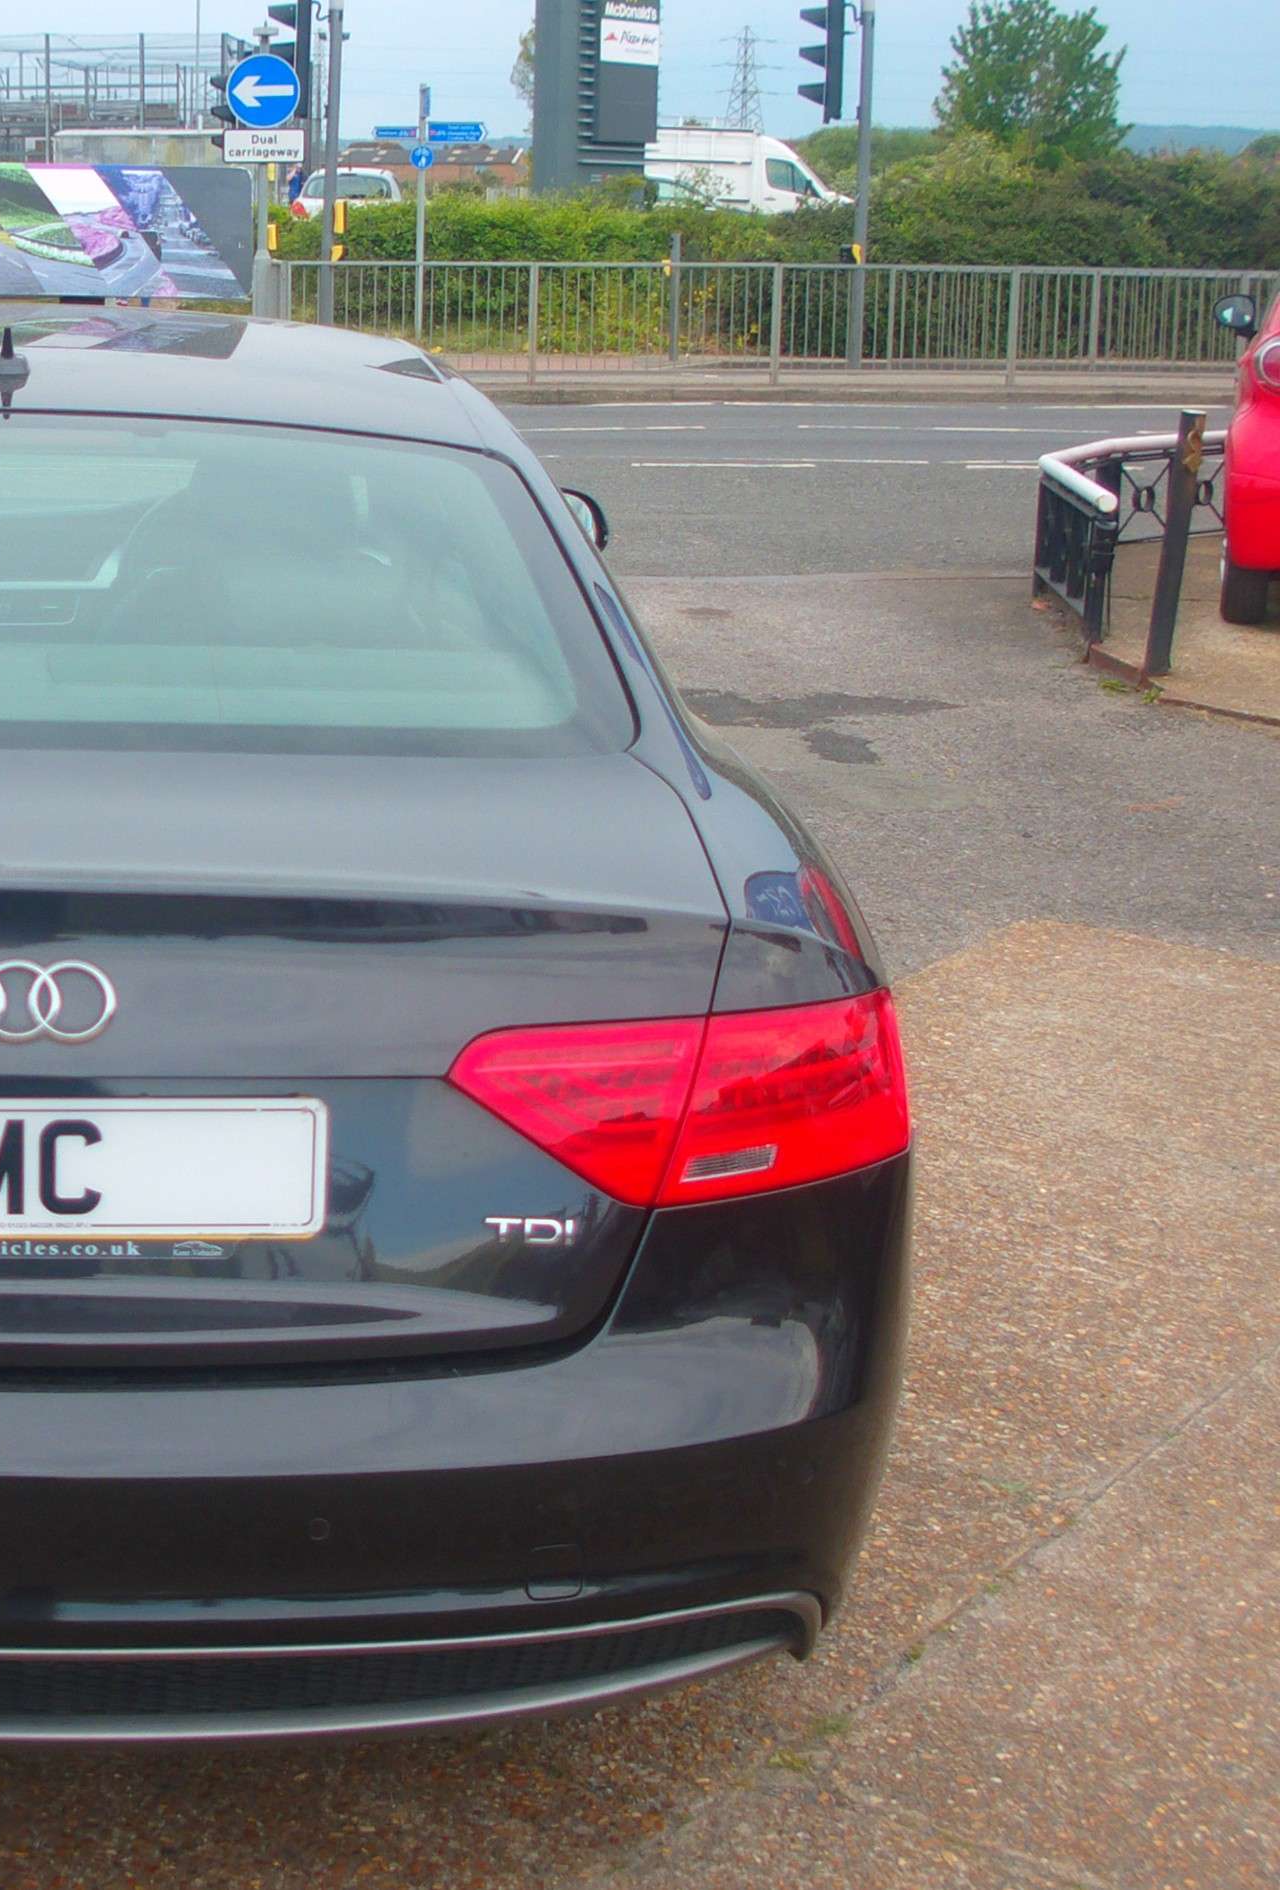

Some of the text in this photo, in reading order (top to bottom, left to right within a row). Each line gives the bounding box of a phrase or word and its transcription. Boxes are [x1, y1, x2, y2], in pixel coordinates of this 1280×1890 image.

[250, 134, 278, 145] Dual
[228, 147, 300, 158] carriageway
[484, 1217, 574, 1245] TDI
